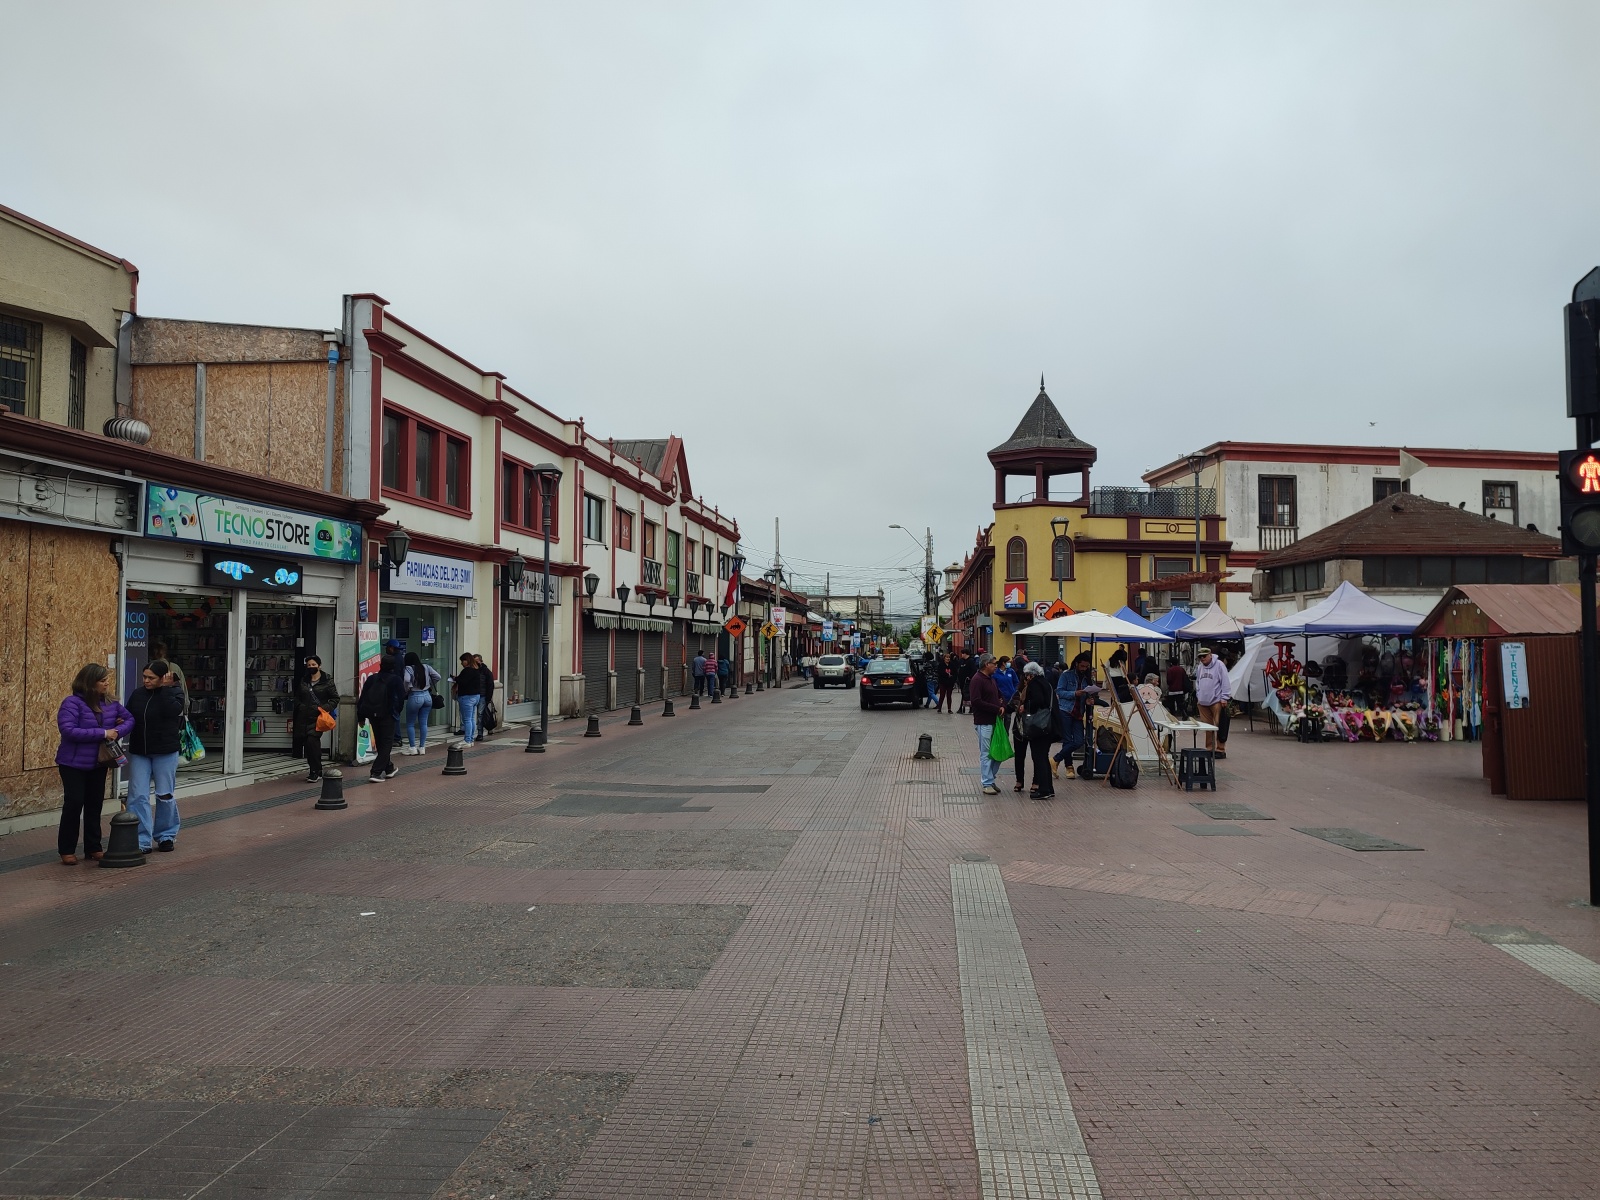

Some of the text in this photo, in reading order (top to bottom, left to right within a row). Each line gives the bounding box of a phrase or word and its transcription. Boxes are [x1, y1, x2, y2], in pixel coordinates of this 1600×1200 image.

[214, 508, 310, 546] TECNOSTORE
[406, 561, 438, 580] FARMACIAS
[440, 566, 450, 580] DEL
[452, 568, 460, 582] DR.
[1510, 654, 1520, 708] TRENZAS
